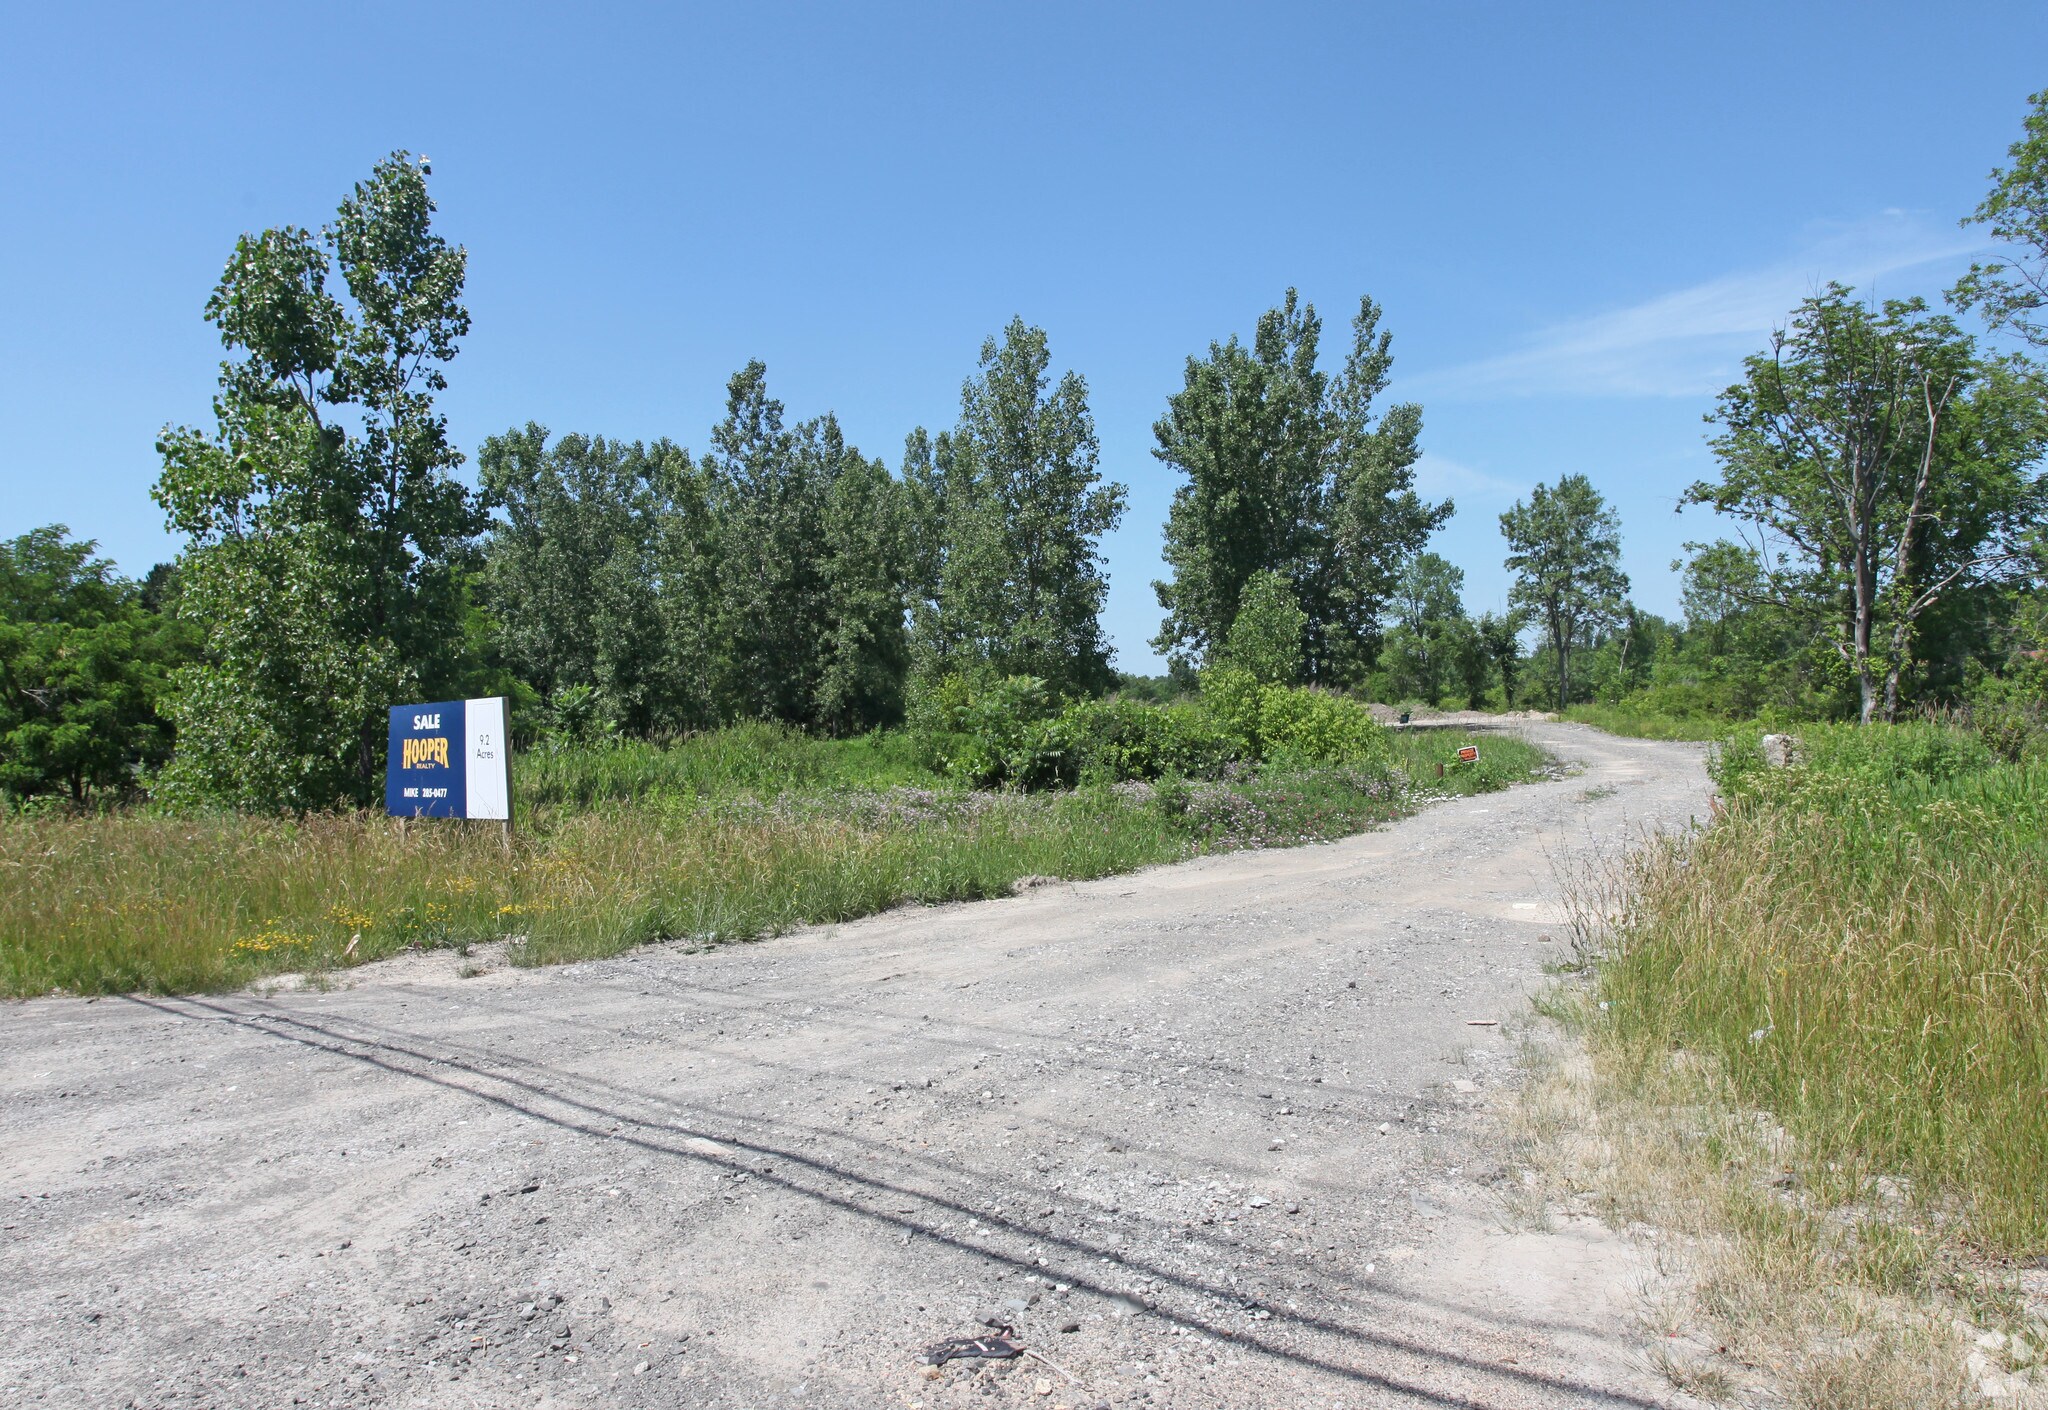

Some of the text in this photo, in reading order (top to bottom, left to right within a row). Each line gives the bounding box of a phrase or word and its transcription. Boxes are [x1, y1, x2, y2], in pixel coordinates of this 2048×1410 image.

[413, 713, 441, 730] SALE
[479, 734, 490, 746] 9.2
[402, 737, 450, 769] HOOPER
[476, 748, 494, 759] Acres
[404, 788, 418, 798] MIKE
